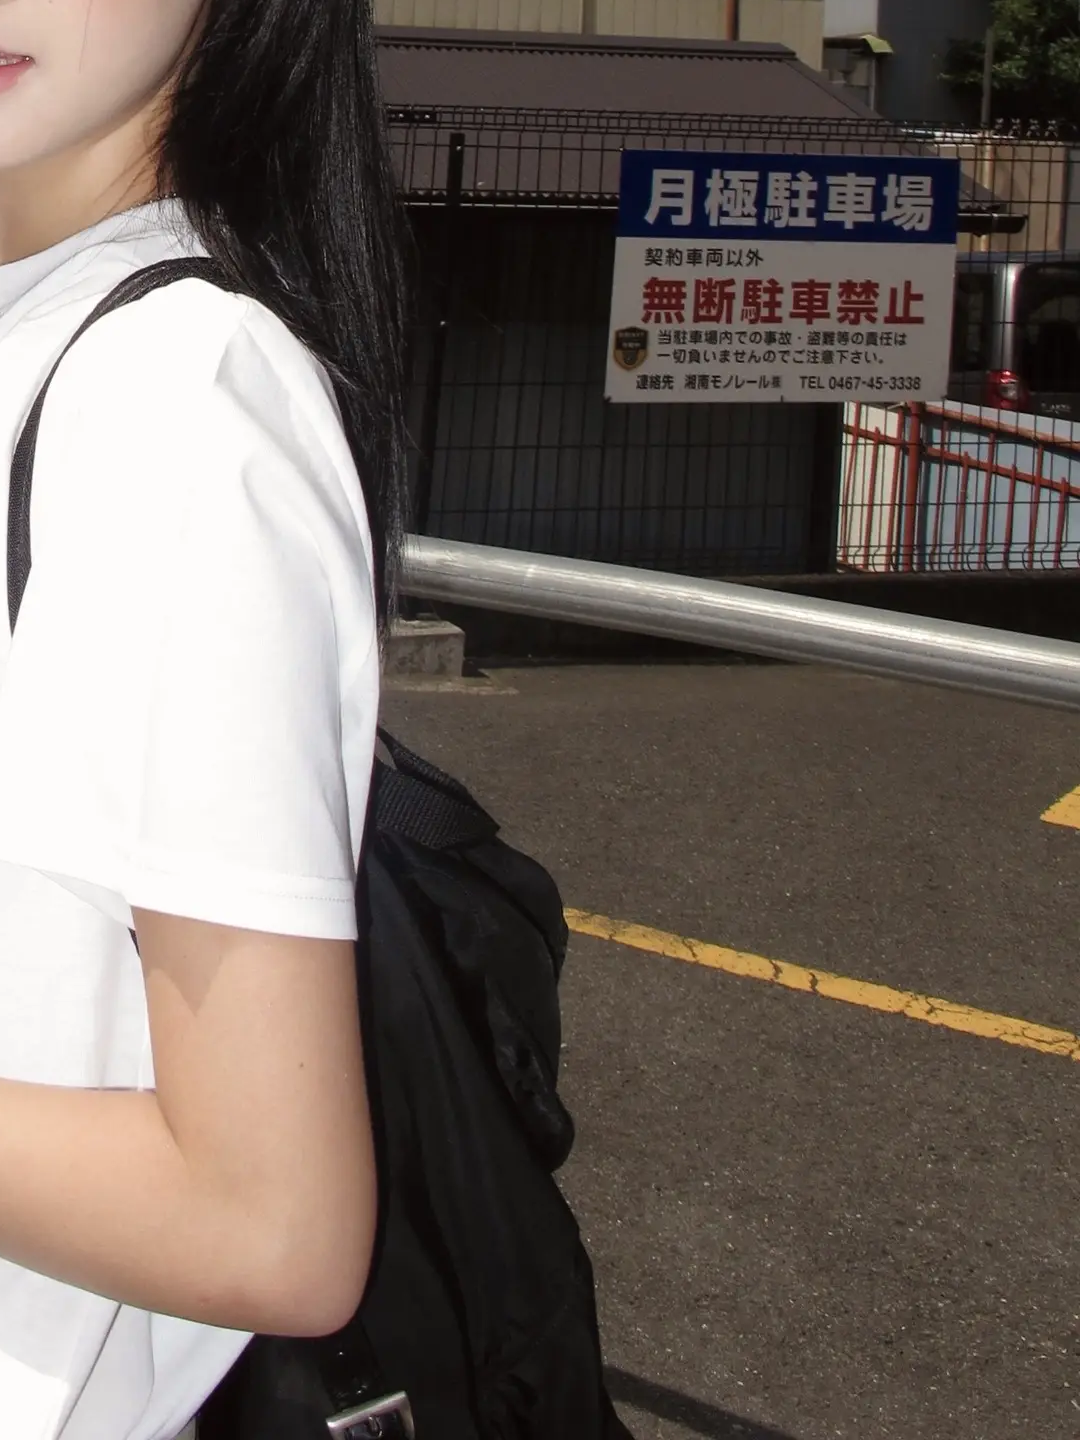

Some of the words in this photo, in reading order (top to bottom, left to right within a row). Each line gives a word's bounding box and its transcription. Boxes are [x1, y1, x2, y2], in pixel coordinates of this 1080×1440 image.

[643, 168, 935, 232] 月極駐車場
[643, 247, 765, 268] 契約車両以外
[640, 276, 926, 326] 無断駐車禁止
[635, 375, 675, 390] 連絡先
[800, 376, 826, 390] TEL
[828, 376, 921, 391] 0467-45-3338
